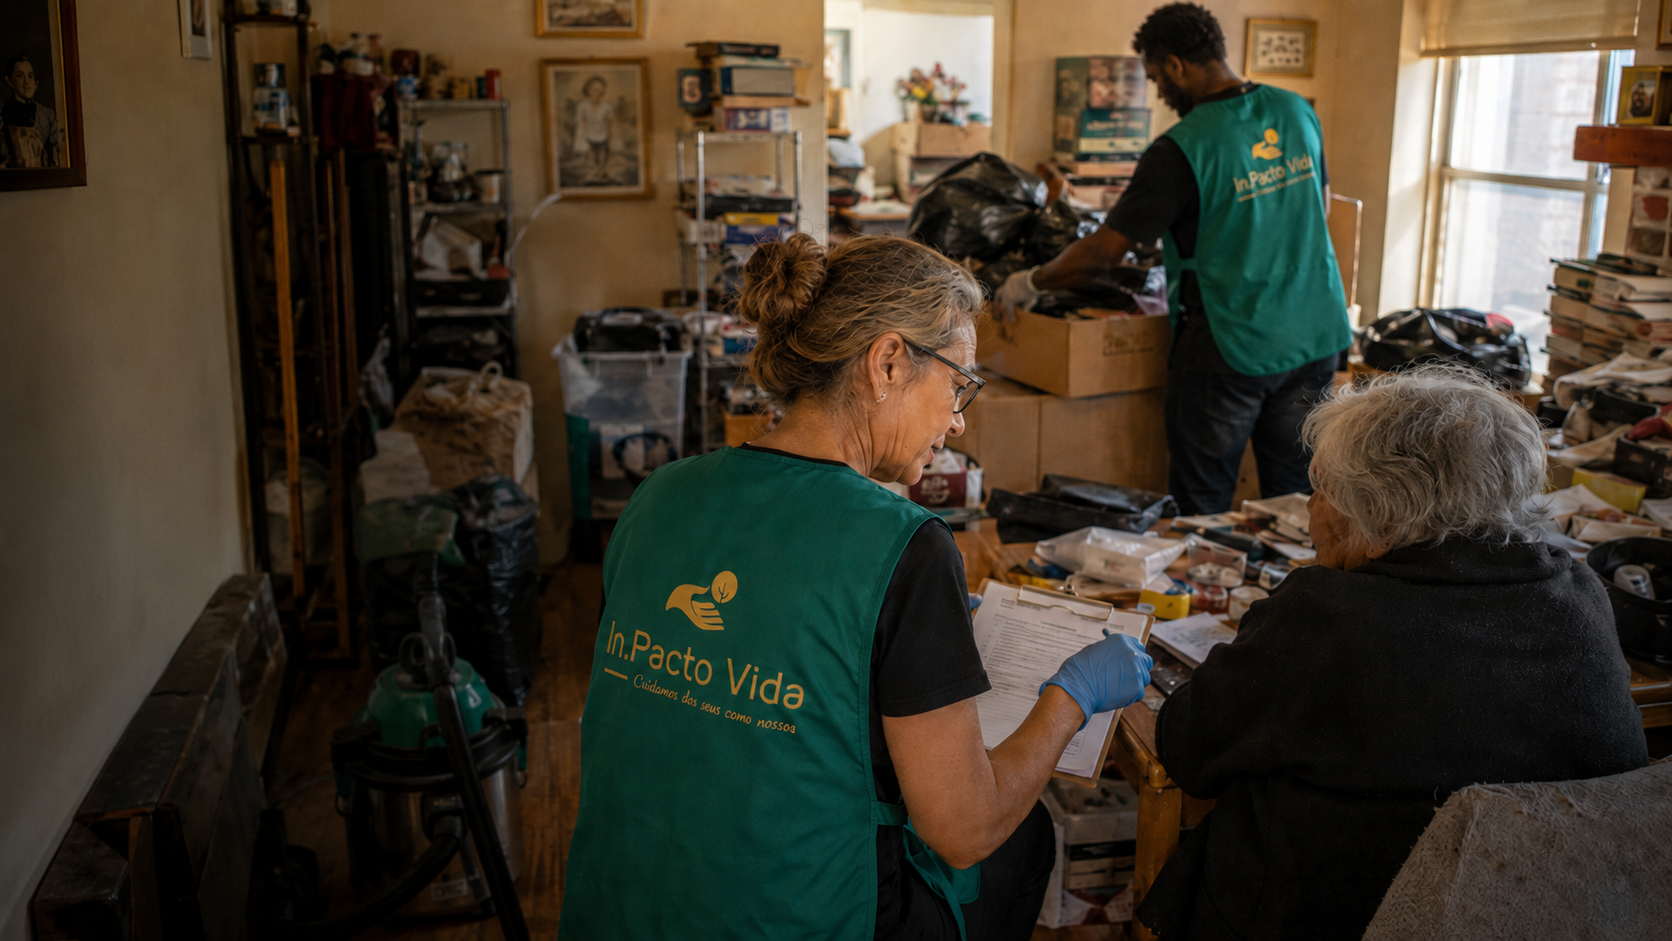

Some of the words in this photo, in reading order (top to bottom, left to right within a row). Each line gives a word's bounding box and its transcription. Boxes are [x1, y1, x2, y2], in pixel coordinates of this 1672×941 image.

[606, 620, 713, 686] In.Pacto
[727, 657, 805, 710] Vida
[633, 673, 679, 701] Cuidamos
[699, 701, 722, 716] seus
[724, 709, 752, 725] como
